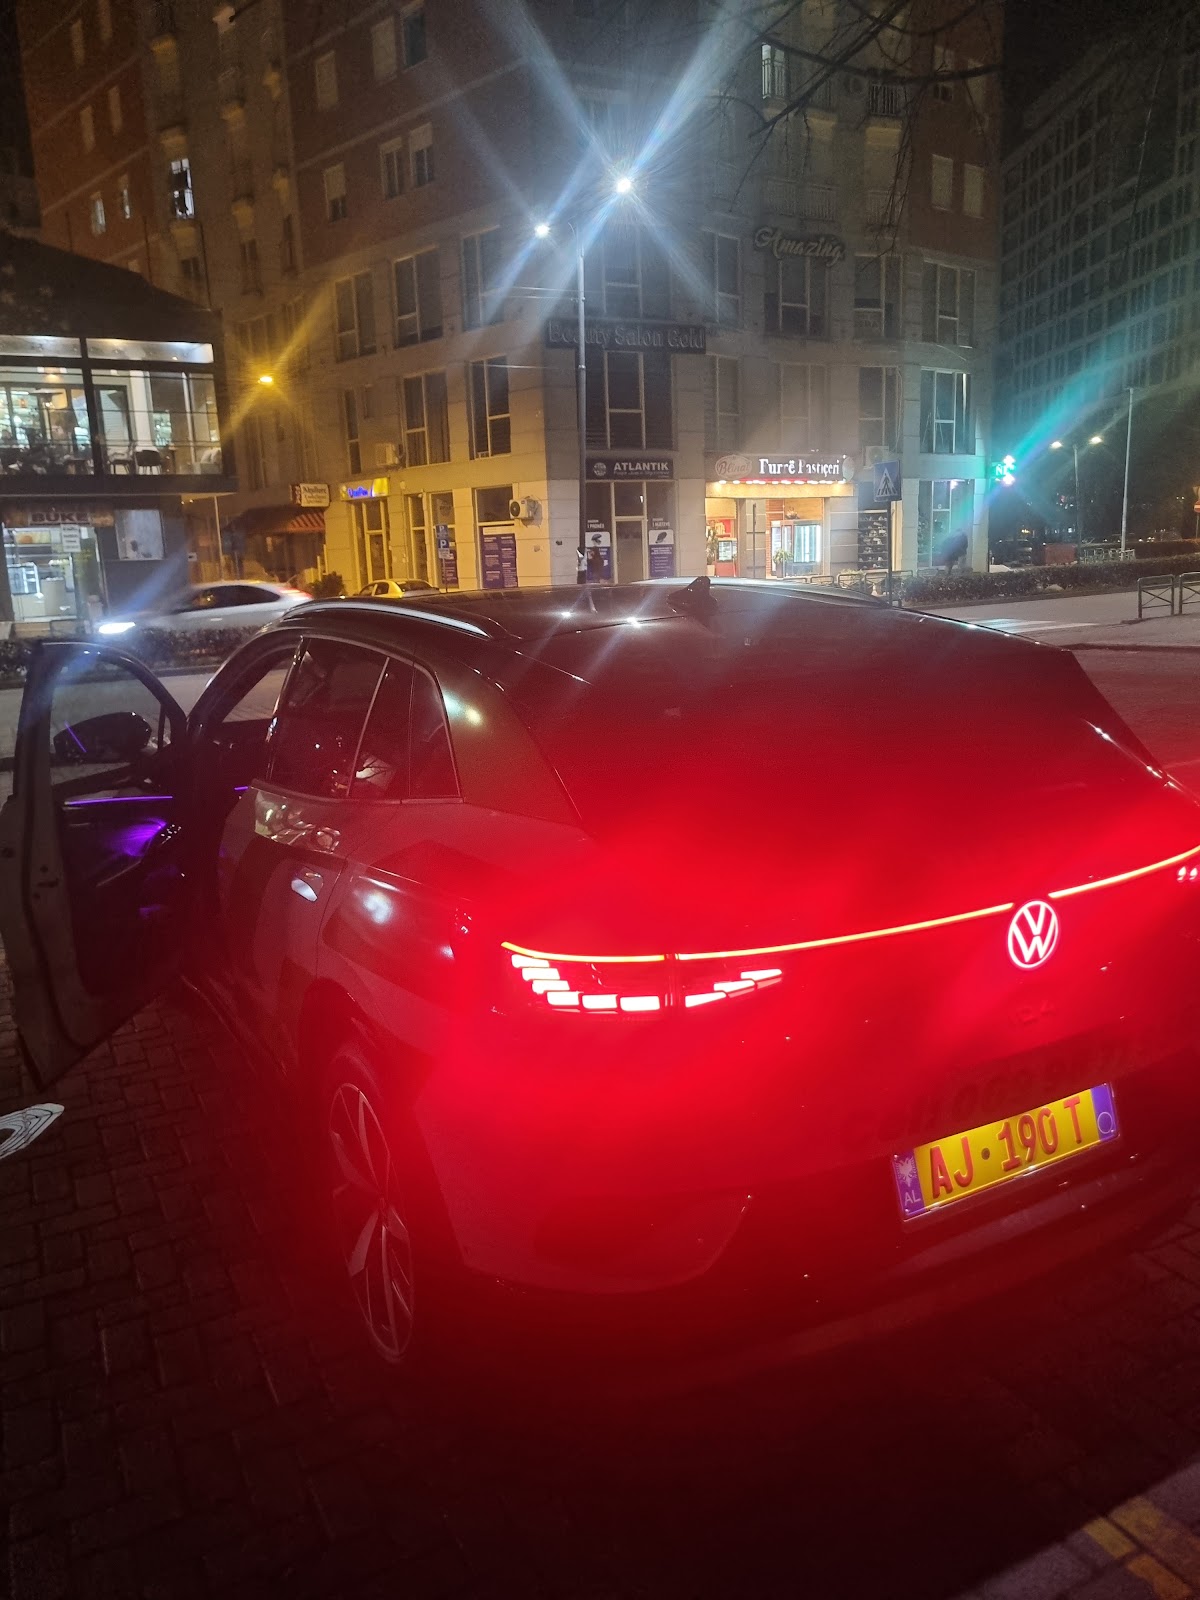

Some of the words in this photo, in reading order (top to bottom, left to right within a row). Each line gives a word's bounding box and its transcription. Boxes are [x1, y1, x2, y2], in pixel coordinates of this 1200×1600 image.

[755, 227, 845, 266] Amazing
[547, 320, 610, 349] Beauty
[614, 324, 664, 347] Salon
[667, 326, 706, 349] Gold
[614, 461, 670, 471] ATLANTIK
[758, 458, 797, 475] Furrë
[440, 539, 447, 549] P
[929, 1136, 975, 1199] AJ
[996, 1106, 1060, 1172] 190
[1063, 1096, 1081, 1145] T
[904, 1189, 922, 1207] AL
